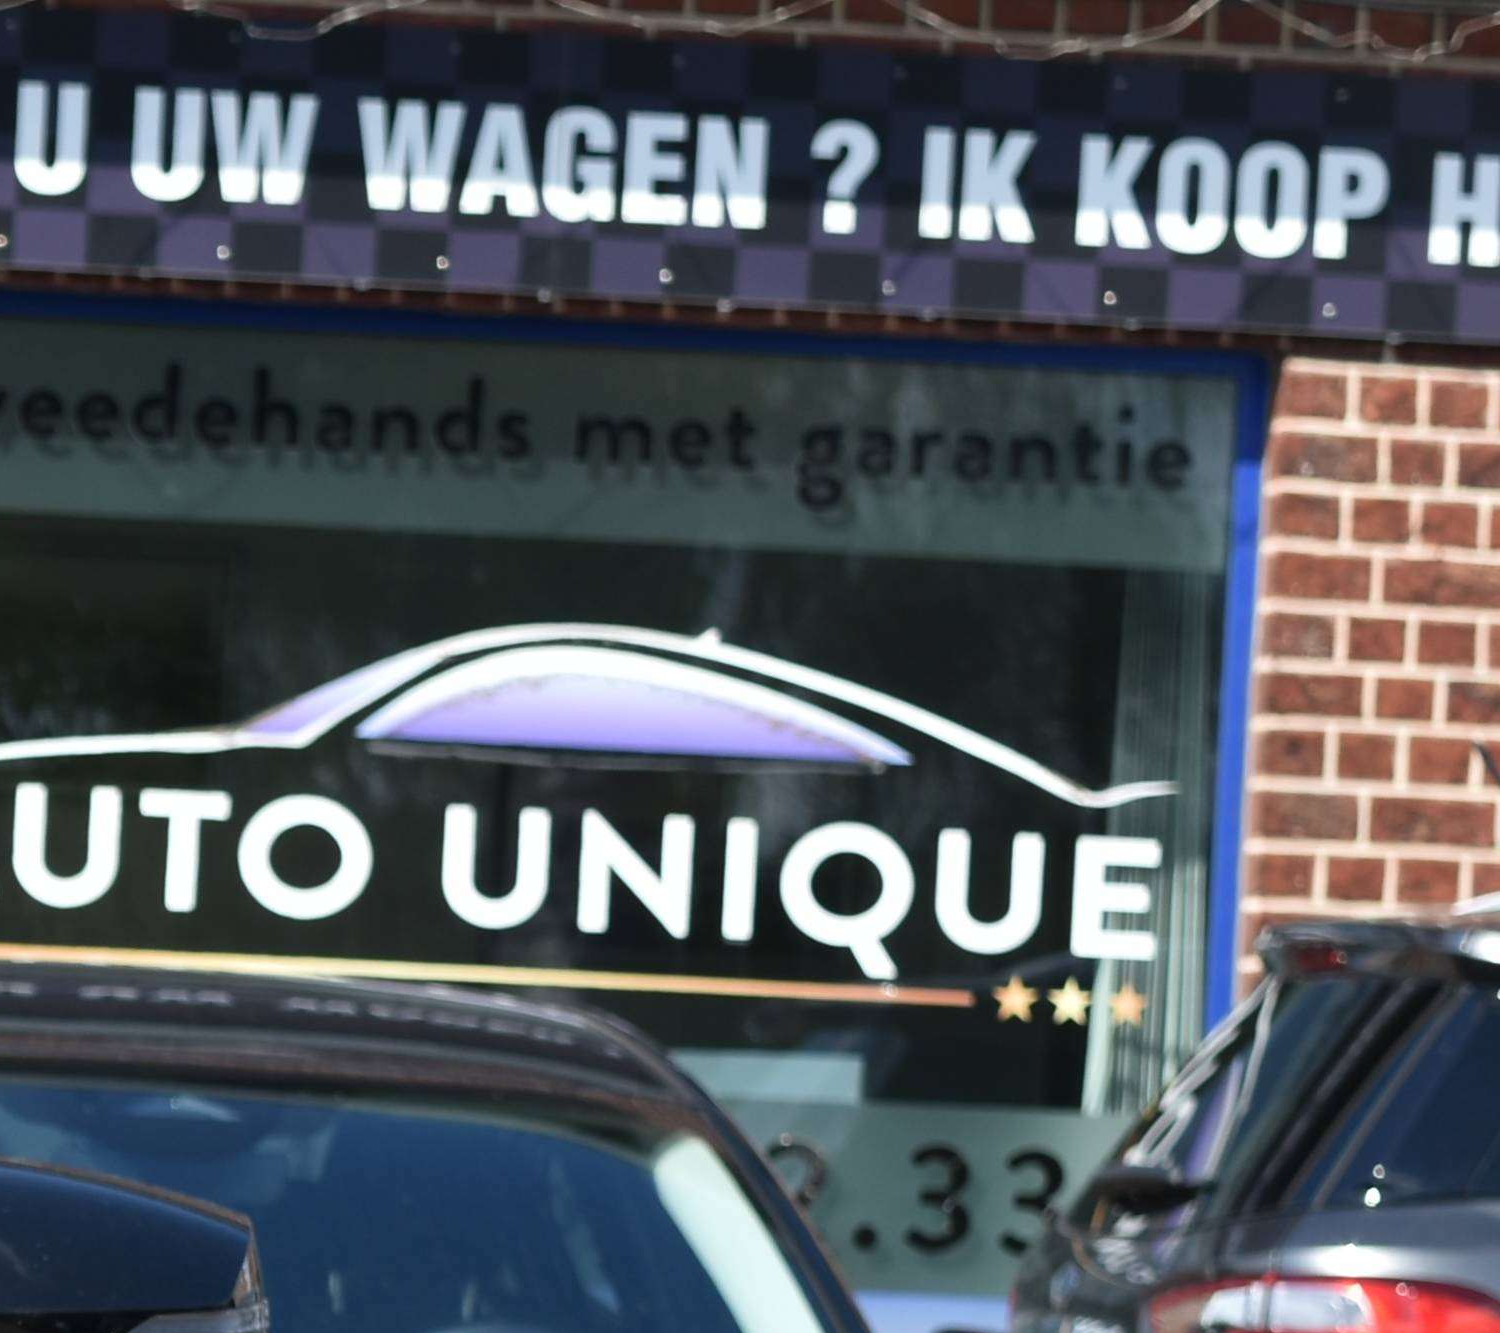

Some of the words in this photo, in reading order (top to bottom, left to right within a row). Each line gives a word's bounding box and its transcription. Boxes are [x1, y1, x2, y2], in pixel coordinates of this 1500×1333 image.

[13, 81, 89, 197] U
[129, 87, 318, 207] UW
[358, 98, 769, 231] WAGEN
[811, 121, 878, 236] ?
[917, 127, 1036, 245] IK
[1073, 136, 1389, 261] KOOP
[572, 405, 758, 473] met
[796, 405, 1192, 513] garantie
[440, 802, 1164, 982] UNIQUE
